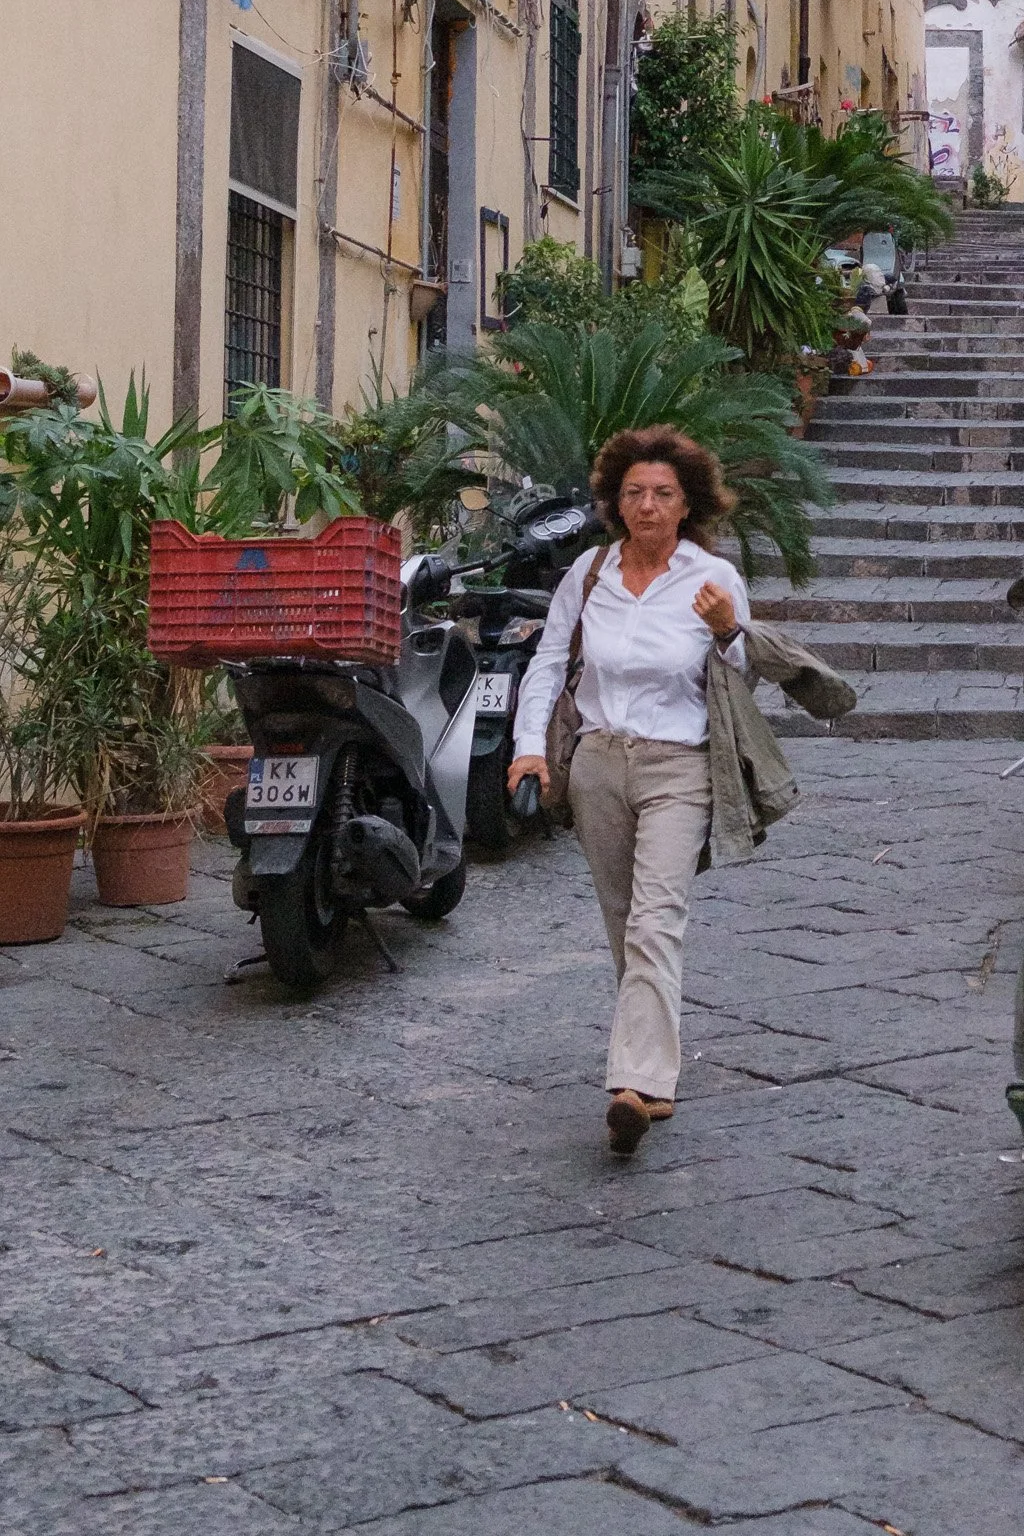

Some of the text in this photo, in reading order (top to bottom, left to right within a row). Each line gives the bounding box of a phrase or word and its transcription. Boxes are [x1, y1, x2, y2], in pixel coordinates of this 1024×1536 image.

[479, 676, 495, 691] K
[476, 694, 504, 708] 5X
[250, 772, 262, 782] PL
[270, 761, 298, 780] KK
[251, 784, 310, 803] 306W
